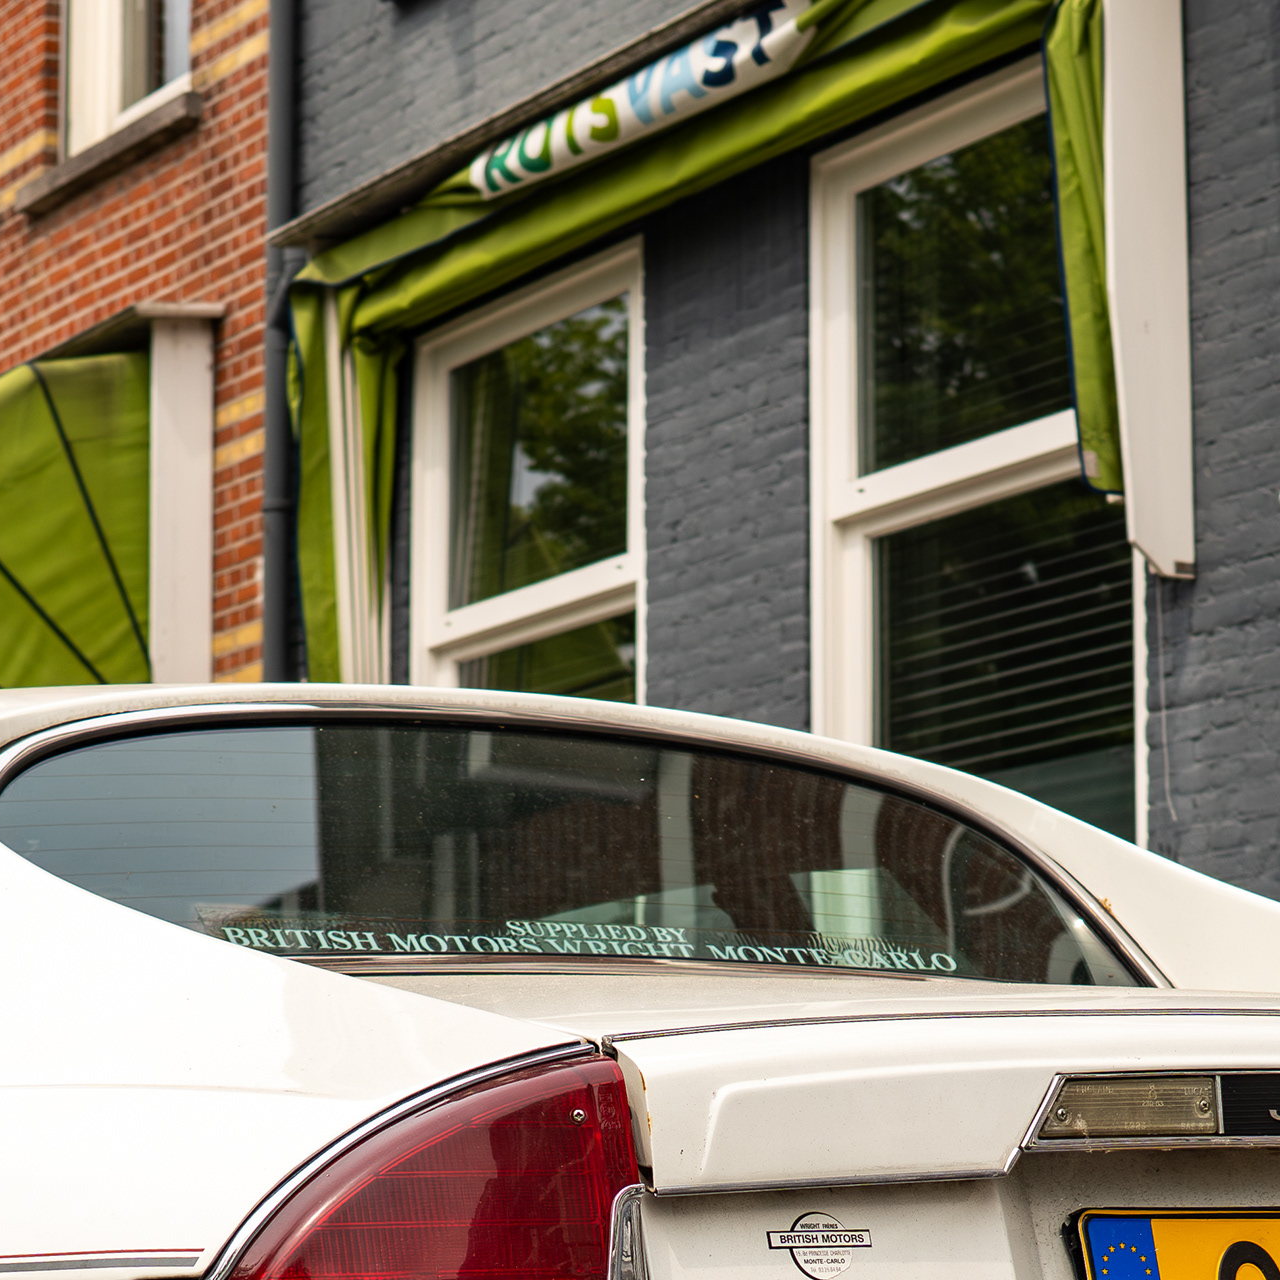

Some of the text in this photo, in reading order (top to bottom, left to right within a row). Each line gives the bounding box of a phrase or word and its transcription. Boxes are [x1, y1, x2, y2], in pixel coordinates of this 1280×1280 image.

[220, 926, 381, 952] BRITISH
[388, 932, 537, 953] MOTORS
[544, 938, 695, 958] WRIGHT
[505, 919, 687, 944] SUPPLIED BY
[780, 1233, 865, 1244] BRITISH MOTORS
